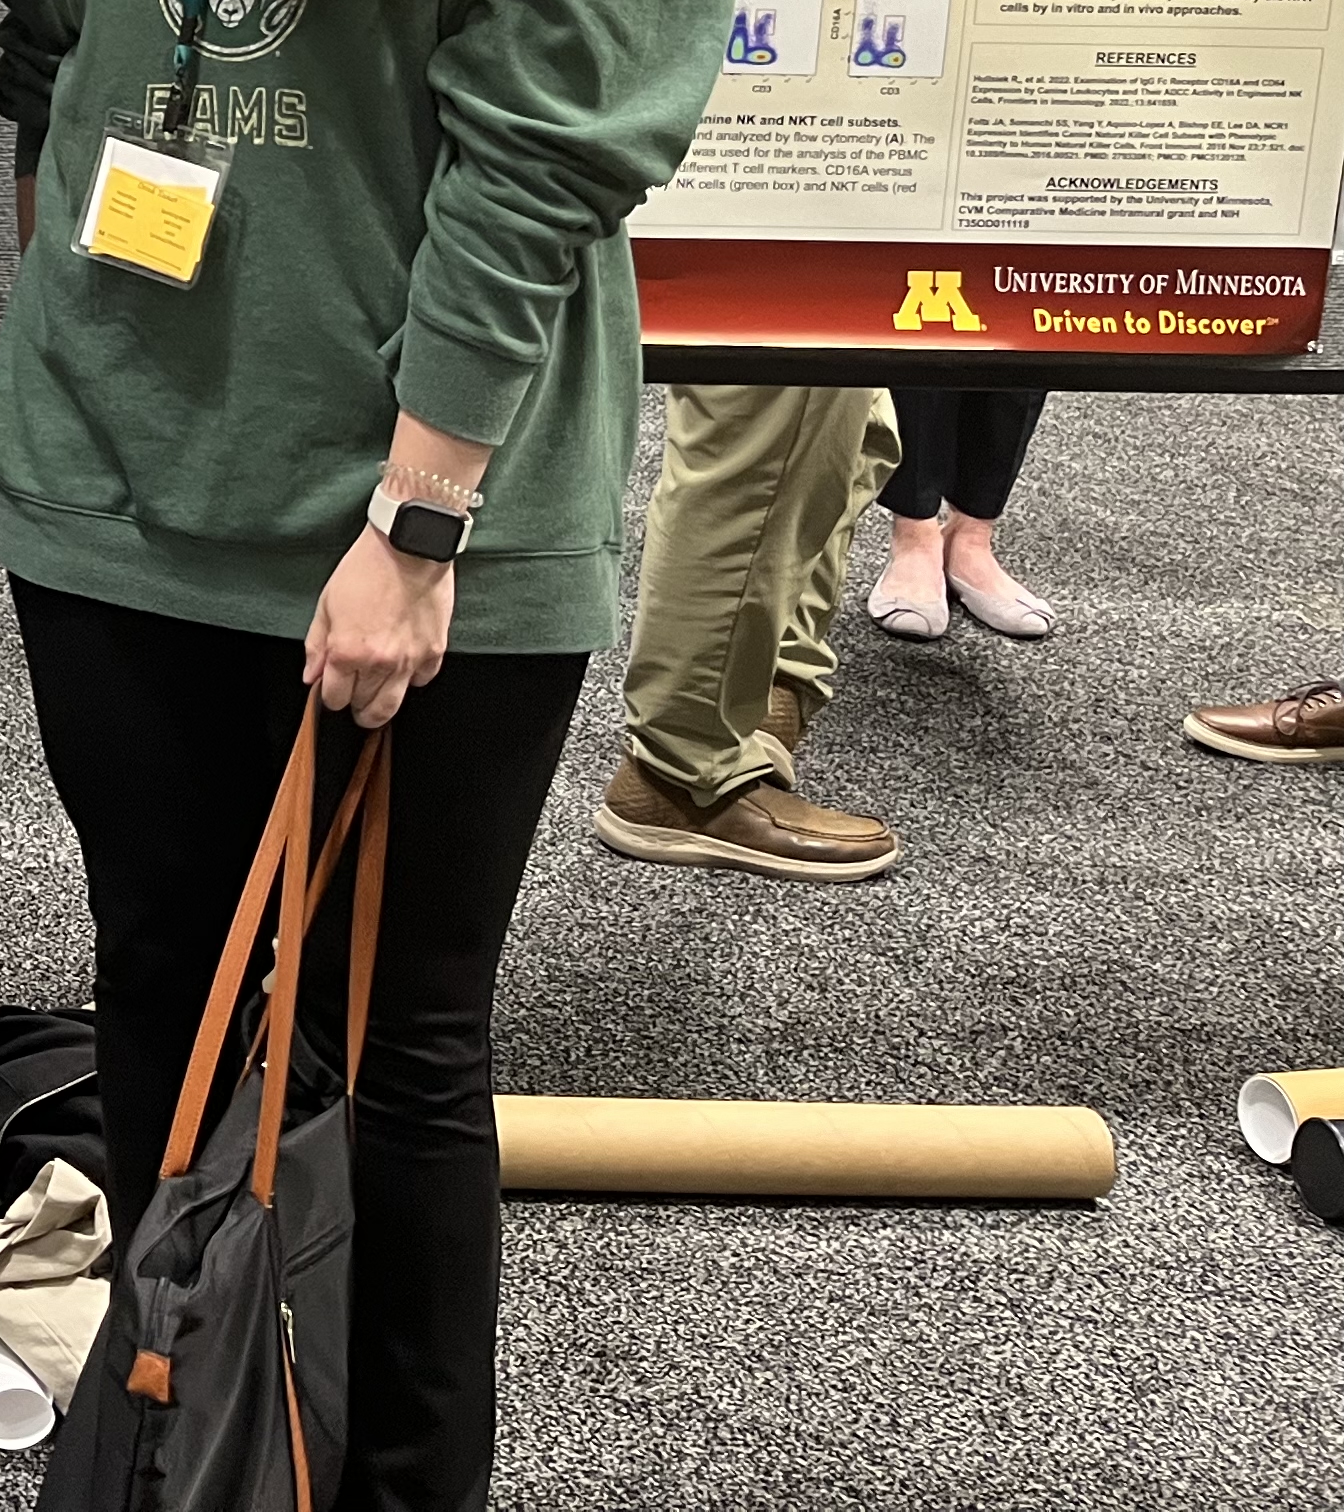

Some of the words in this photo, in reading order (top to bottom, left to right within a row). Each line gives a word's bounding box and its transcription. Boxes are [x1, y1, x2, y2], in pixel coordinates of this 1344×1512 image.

[1095, 51, 1197, 68] REFERENCES
[1045, 176, 1219, 194] ACKNOWLEDGEMENTS
[994, 266, 1135, 294] UNIVERSITY
[1139, 273, 1170, 295] OF
[1174, 268, 1307, 297] MINNESOTA
[1033, 308, 1118, 334] Driven
[1123, 310, 1151, 334] to
